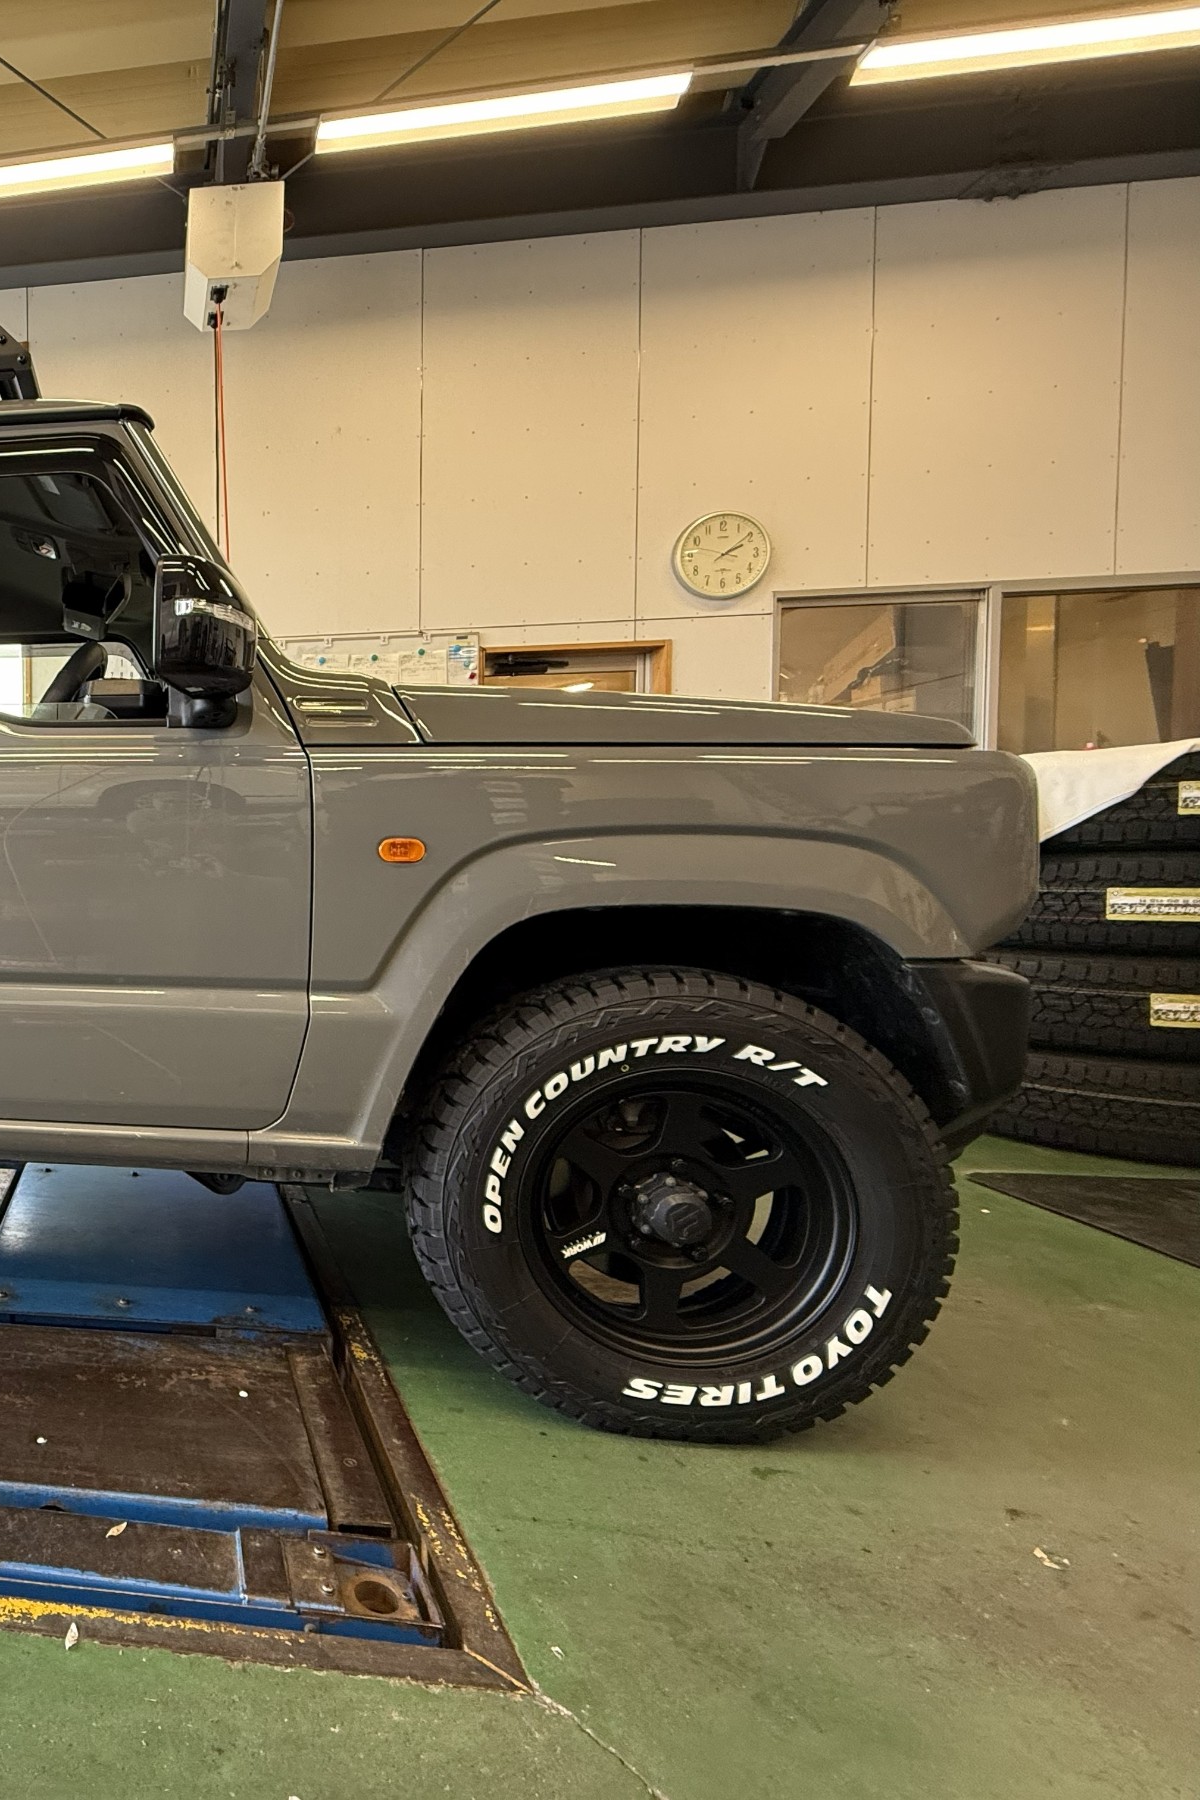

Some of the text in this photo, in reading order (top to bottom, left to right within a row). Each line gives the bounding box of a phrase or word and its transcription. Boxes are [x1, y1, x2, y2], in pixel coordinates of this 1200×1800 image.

[705, 525, 711, 535] 11
[720, 520, 727, 531] 12
[737, 523, 740, 534] 1
[693, 535, 701, 547] 10
[747, 531, 754, 543] 2
[753, 547, 759, 558] 3
[693, 565, 699, 576] 8
[746, 562, 752, 574] 4
[705, 575, 710, 586] 7
[720, 578, 725, 588] 6
[735, 573, 741, 584] 5
[483, 1035, 829, 1235] OPEN COUNTRY R/T
[621, 1284, 893, 1407] TOYO TIRES
